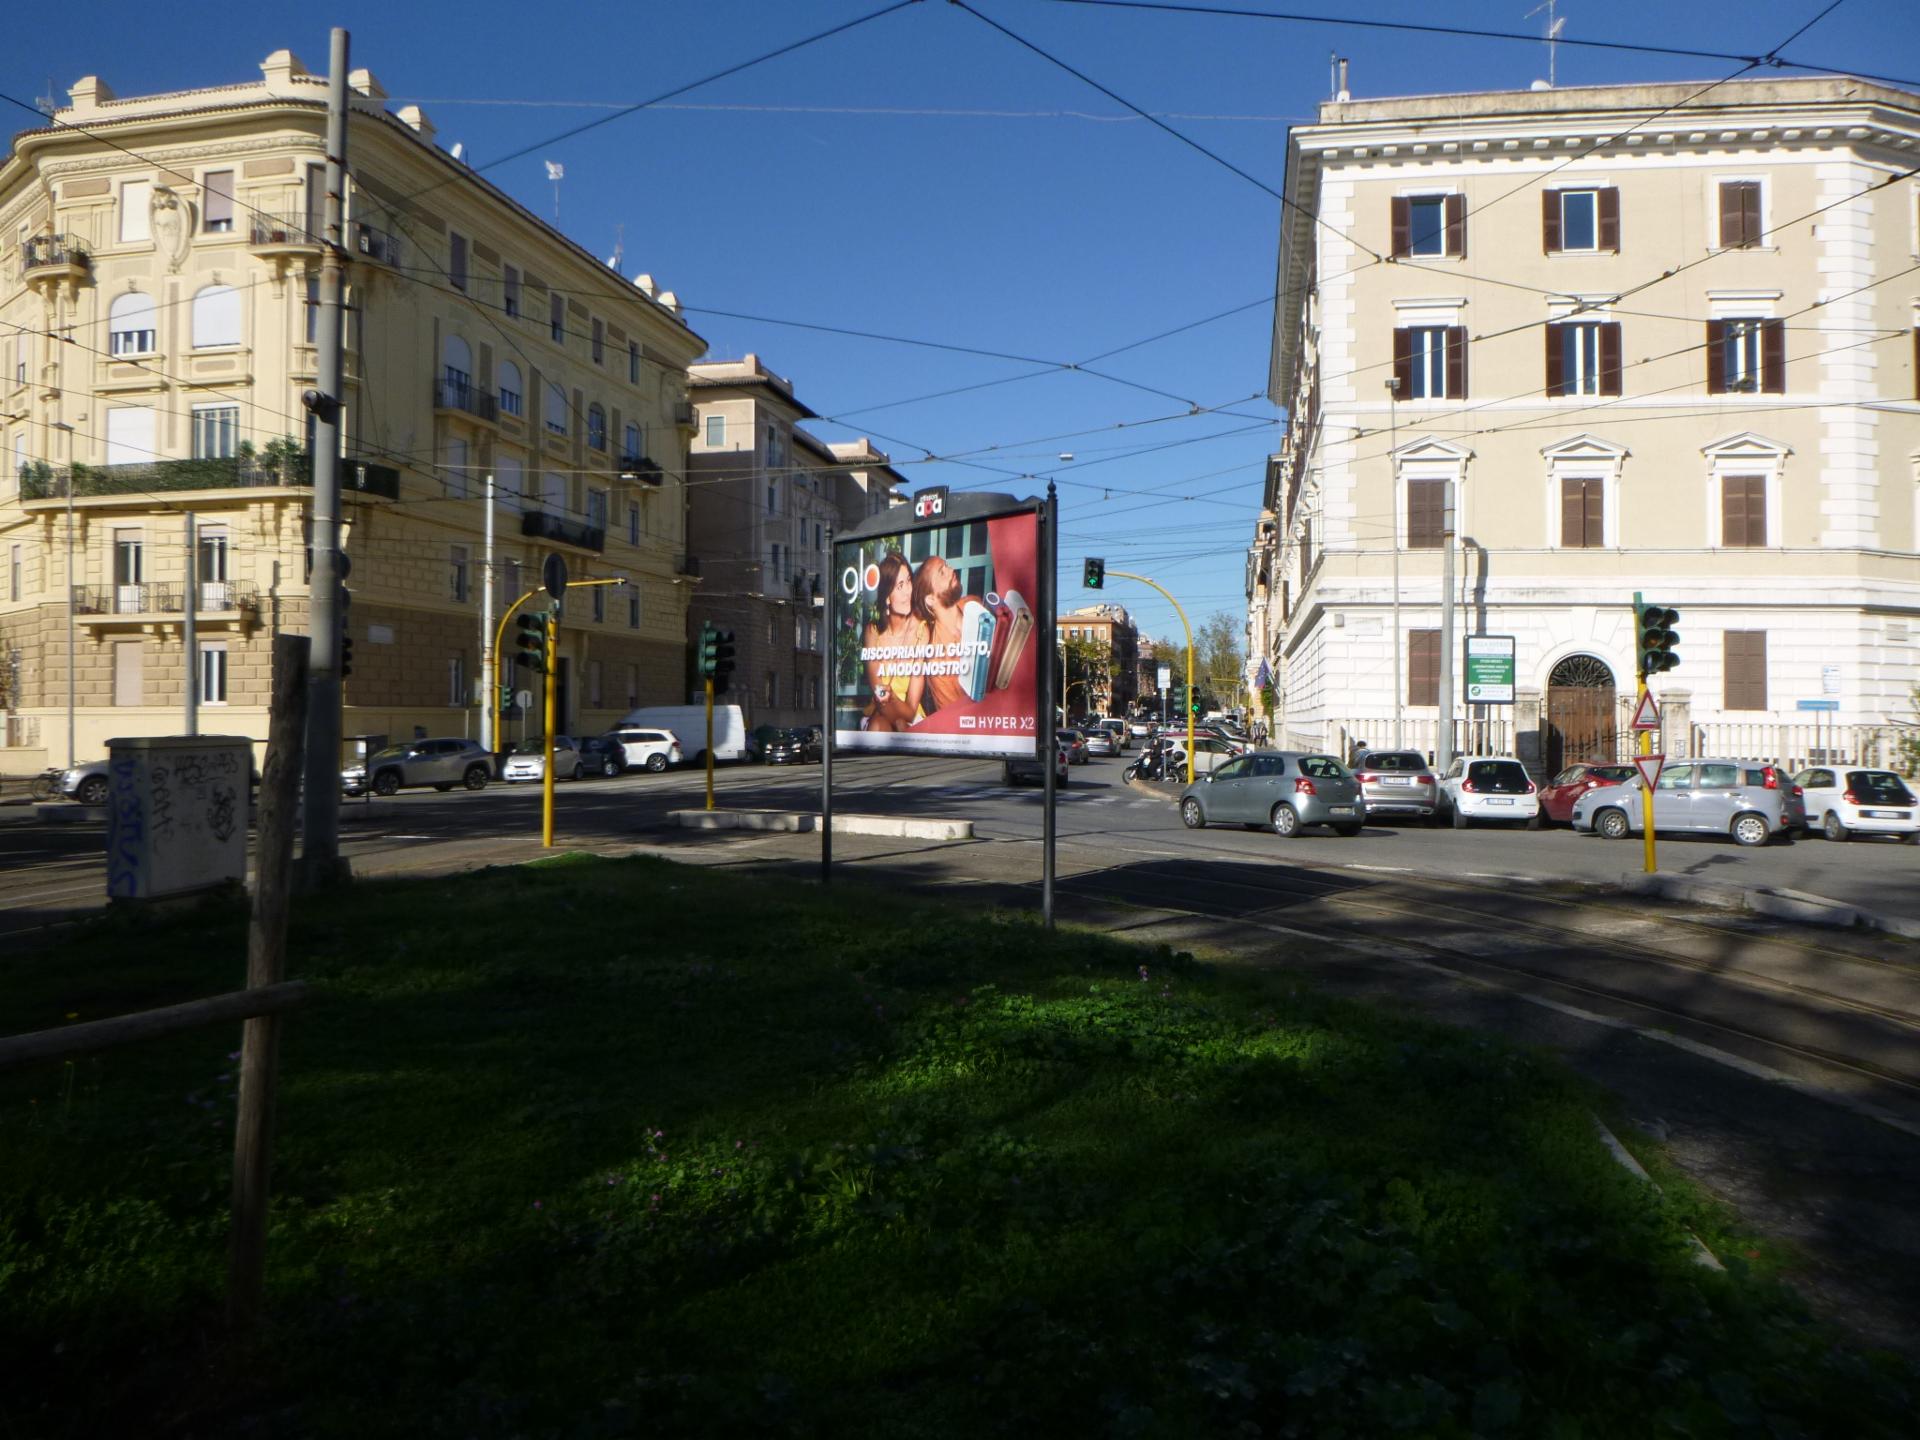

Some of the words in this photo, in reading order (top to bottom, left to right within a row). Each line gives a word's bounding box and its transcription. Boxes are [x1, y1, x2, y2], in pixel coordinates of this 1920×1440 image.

[915, 498, 942, 518] apa
[843, 548, 880, 604] glo
[861, 644, 934, 660] RISCOPRIAMO
[934, 644, 945, 657] IL
[946, 641, 990, 658] GUSTO,
[877, 663, 886, 676] A
[887, 662, 921, 676] MODO
[922, 660, 970, 676] NOSTRO
[978, 716, 1017, 729] HYPER
[1020, 716, 1035, 729] X2
